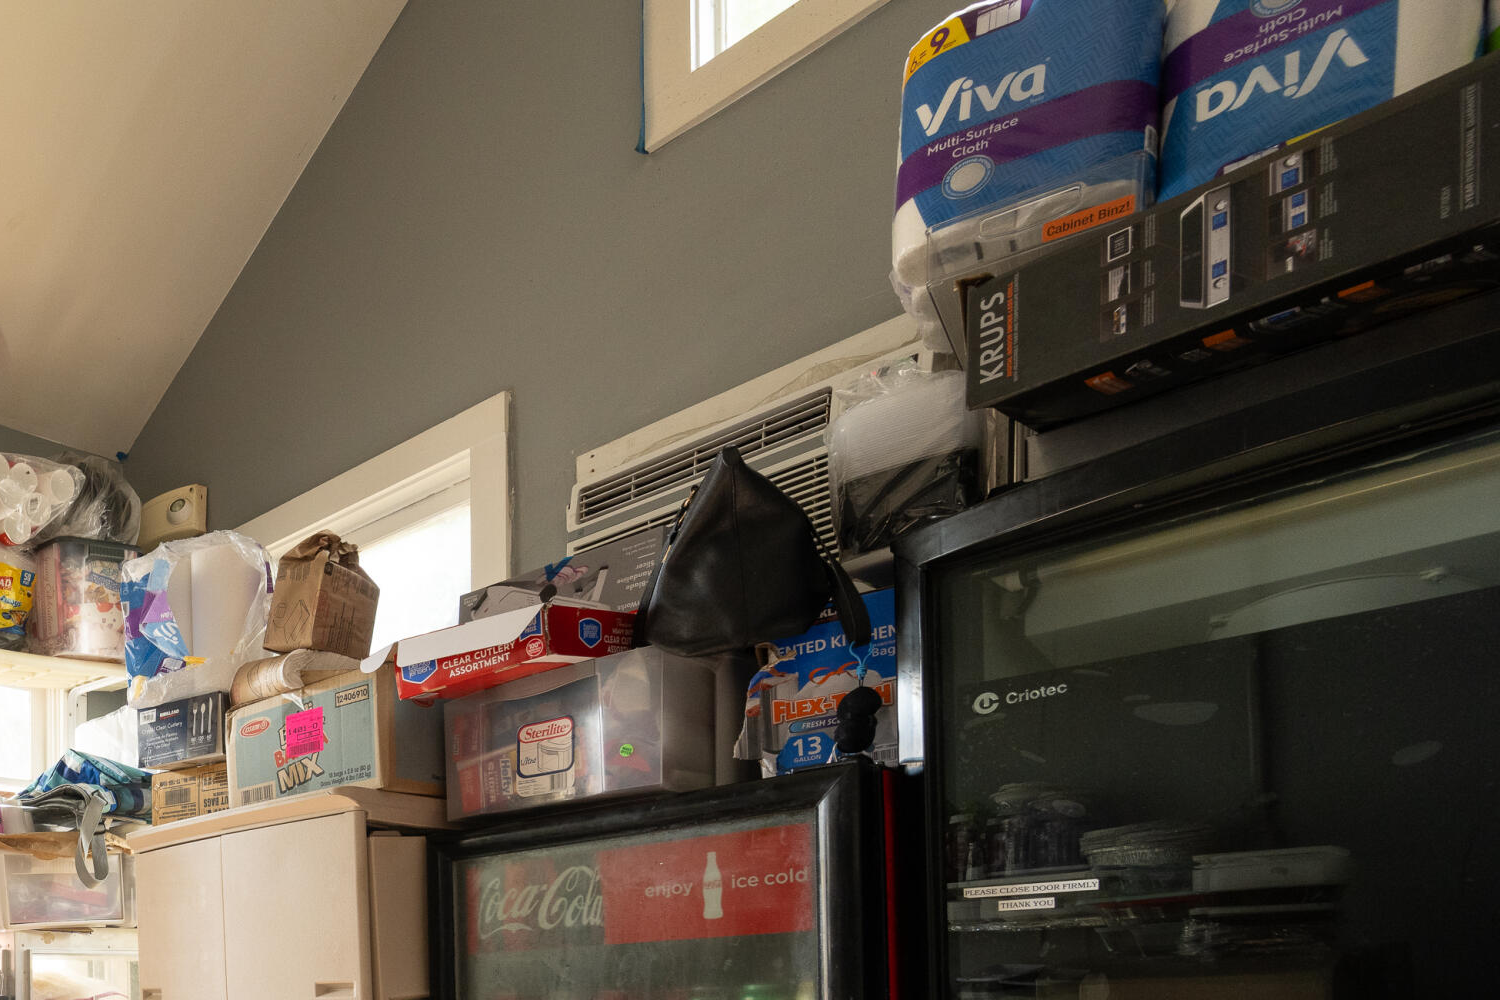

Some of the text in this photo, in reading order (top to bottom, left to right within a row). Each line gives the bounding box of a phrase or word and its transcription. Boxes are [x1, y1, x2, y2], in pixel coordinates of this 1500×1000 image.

[1224, 7, 1343, 63] Multi-Surface
[1195, 29, 1368, 122] Viva
[916, 64, 1049, 137] Viva
[927, 116, 1019, 157] Multi-Surface
[951, 138, 990, 159] Cloth
[1046, 199, 1131, 239] Cabinet Binz!
[979, 290, 1006, 385] KRUPS
[442, 641, 515, 671] CLEAR CUTLERY
[779, 639, 826, 656] ENTED
[449, 652, 510, 678] ASSORTMENT
[1005, 682, 1068, 706] Criotec
[524, 724, 566, 742] Sterilite
[802, 719, 826, 729] FRESH
[793, 735, 822, 757] 13
[277, 752, 325, 793] MIX
[501, 759, 511, 795] Hefty
[644, 867, 808, 898] enjoy ice cold
[963, 879, 1097, 898] PLEASE CLOSE DOOR FIRMLY
[479, 866, 604, 940] Coca-Cola
[1000, 898, 1054, 910] THANK YOU
